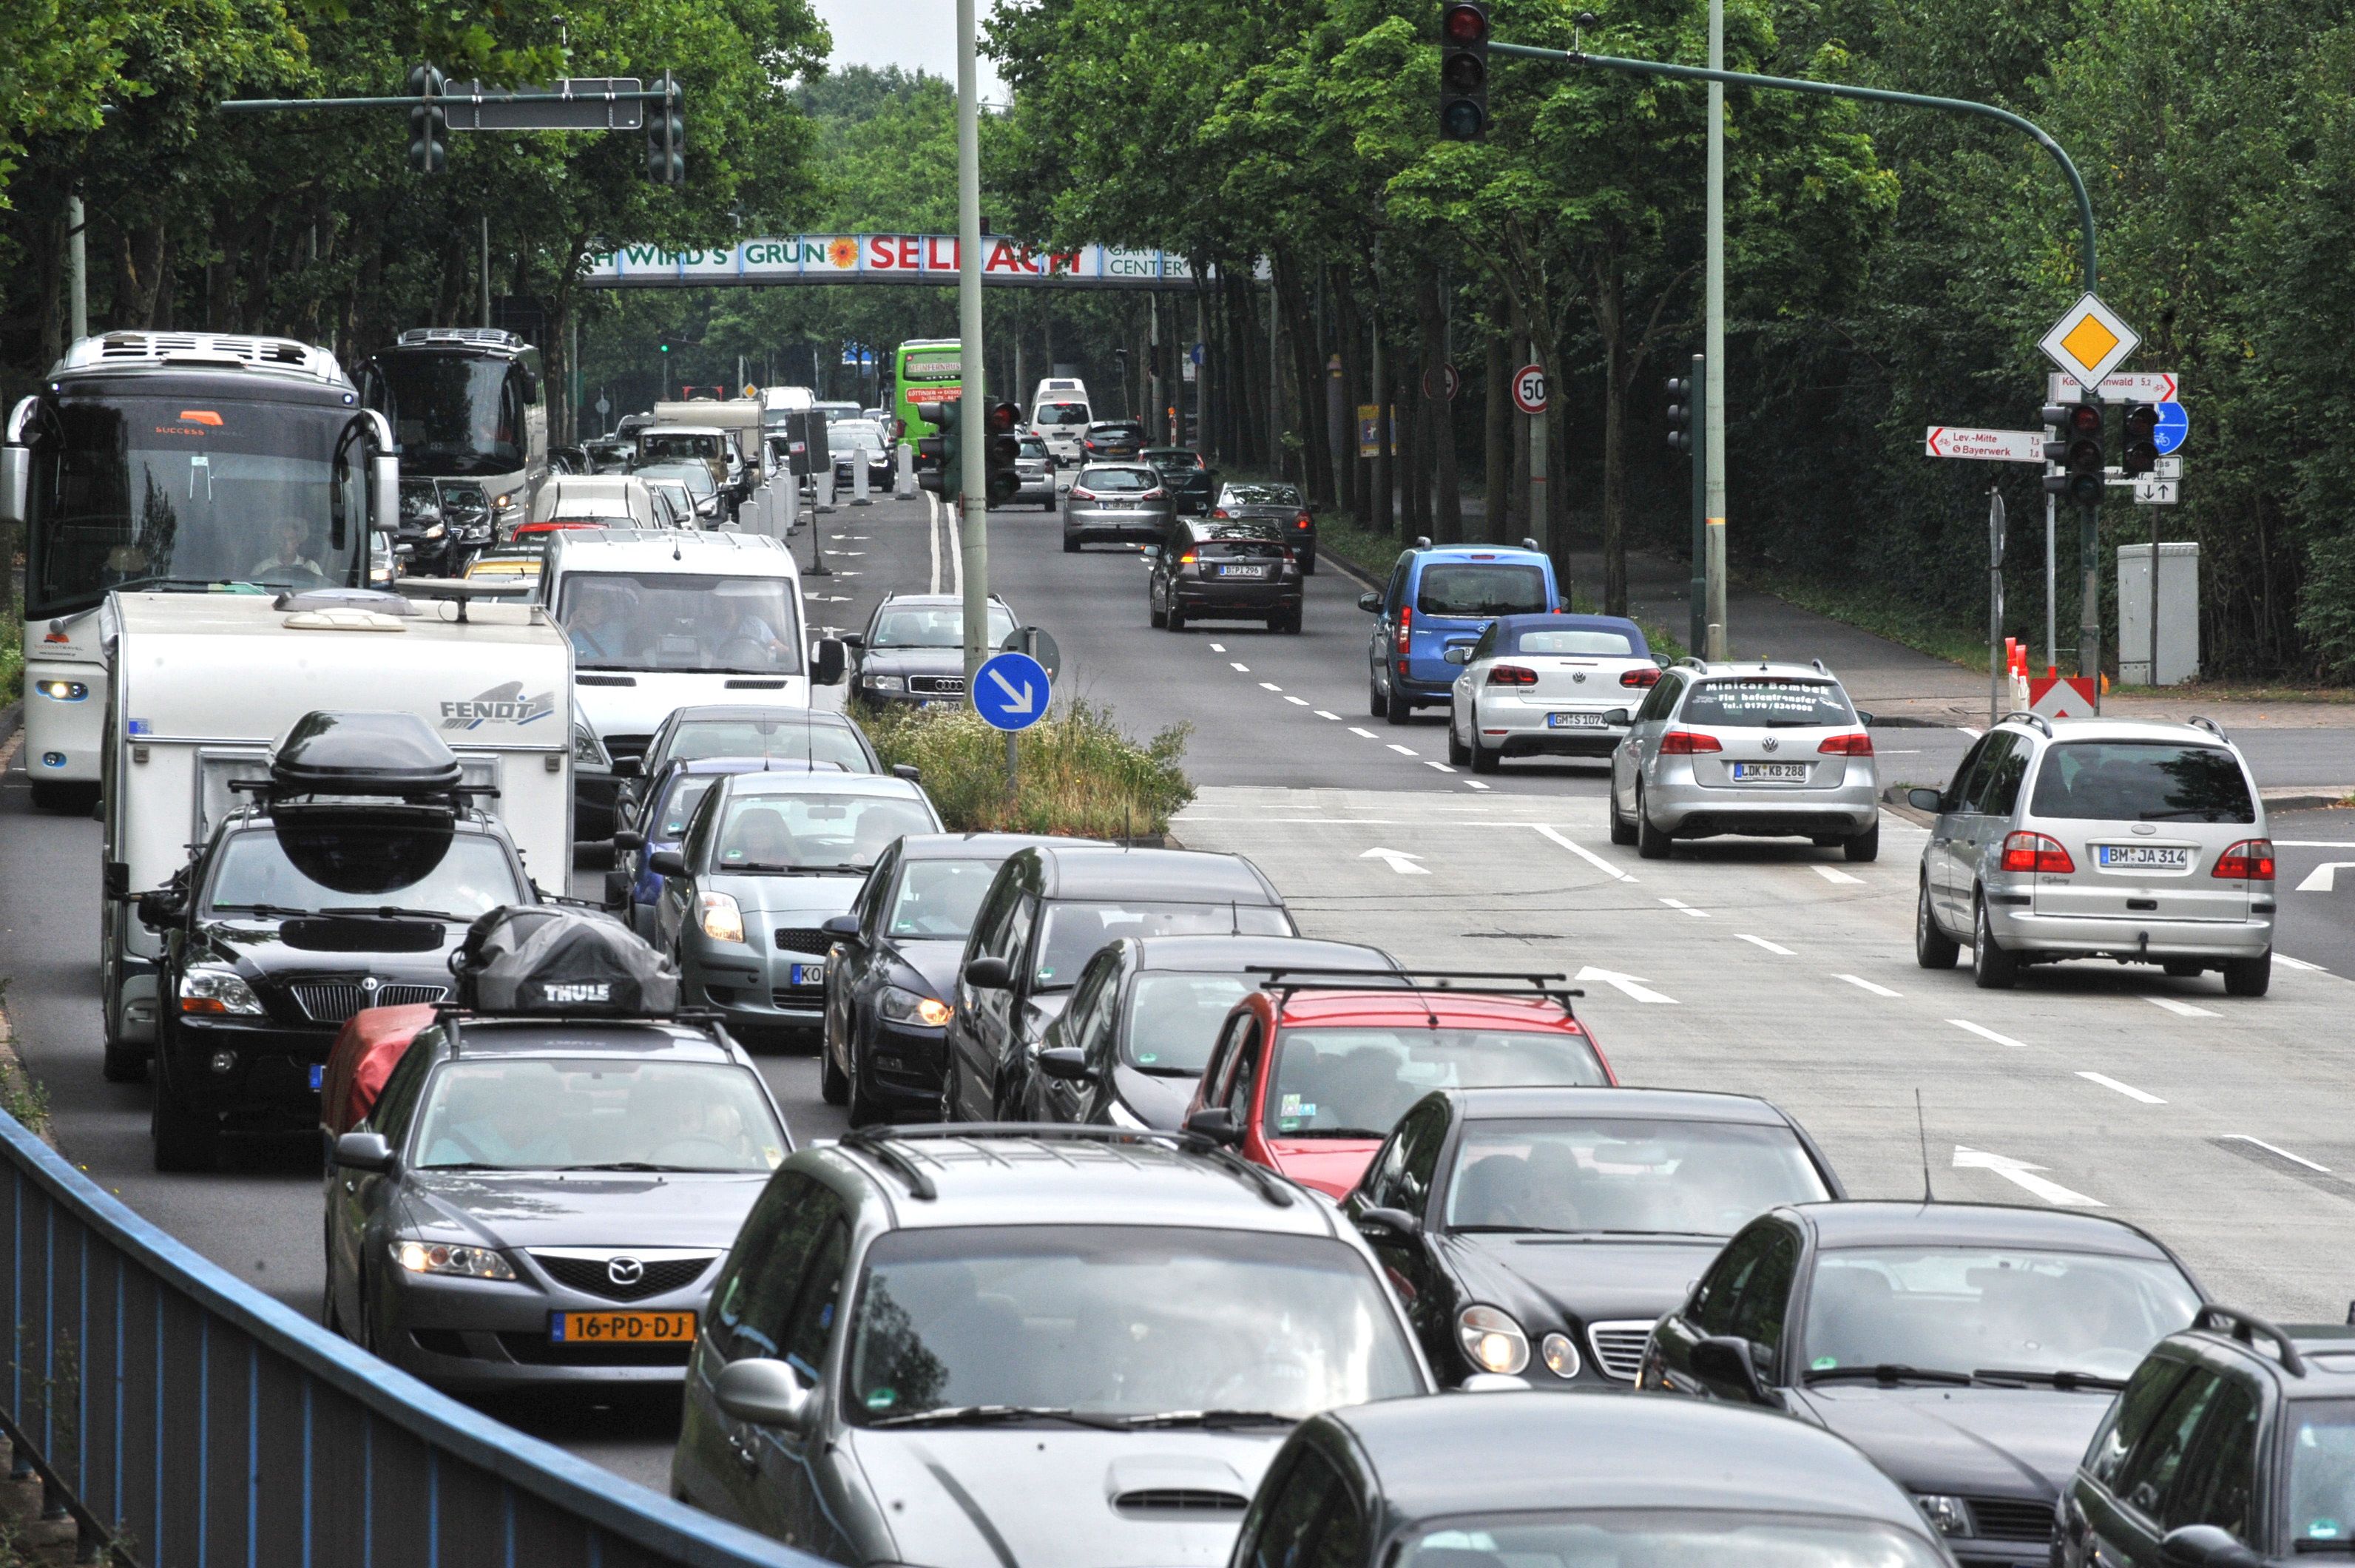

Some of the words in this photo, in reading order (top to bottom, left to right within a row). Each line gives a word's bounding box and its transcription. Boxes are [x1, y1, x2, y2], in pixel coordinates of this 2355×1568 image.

[746, 237, 825, 264] GRÜN
[870, 235, 1081, 274] SELACH
[1110, 259, 1183, 275] CENTER
[1523, 379, 1546, 400] 50
[1953, 432, 1998, 443] Lev.-Mitte
[1962, 445, 2011, 456] Bayerwerk
[1706, 682, 1765, 692] Minicar
[1768, 683, 1829, 695] Bombek
[440, 701, 535, 719] FENDT
[1555, 714, 1568, 725] GM
[1574, 714, 1581, 725] S
[1742, 765, 1761, 777] LDK
[1769, 765, 1782, 777] KB
[1785, 766, 1804, 777] 288
[2109, 848, 2129, 862] BM
[2138, 849, 2156, 863] JA
[2158, 849, 2186, 864] 314
[801, 966, 821, 982] KO
[544, 984, 609, 1002] THULE
[575, 1316, 683, 1338] 16-PD-DJ
